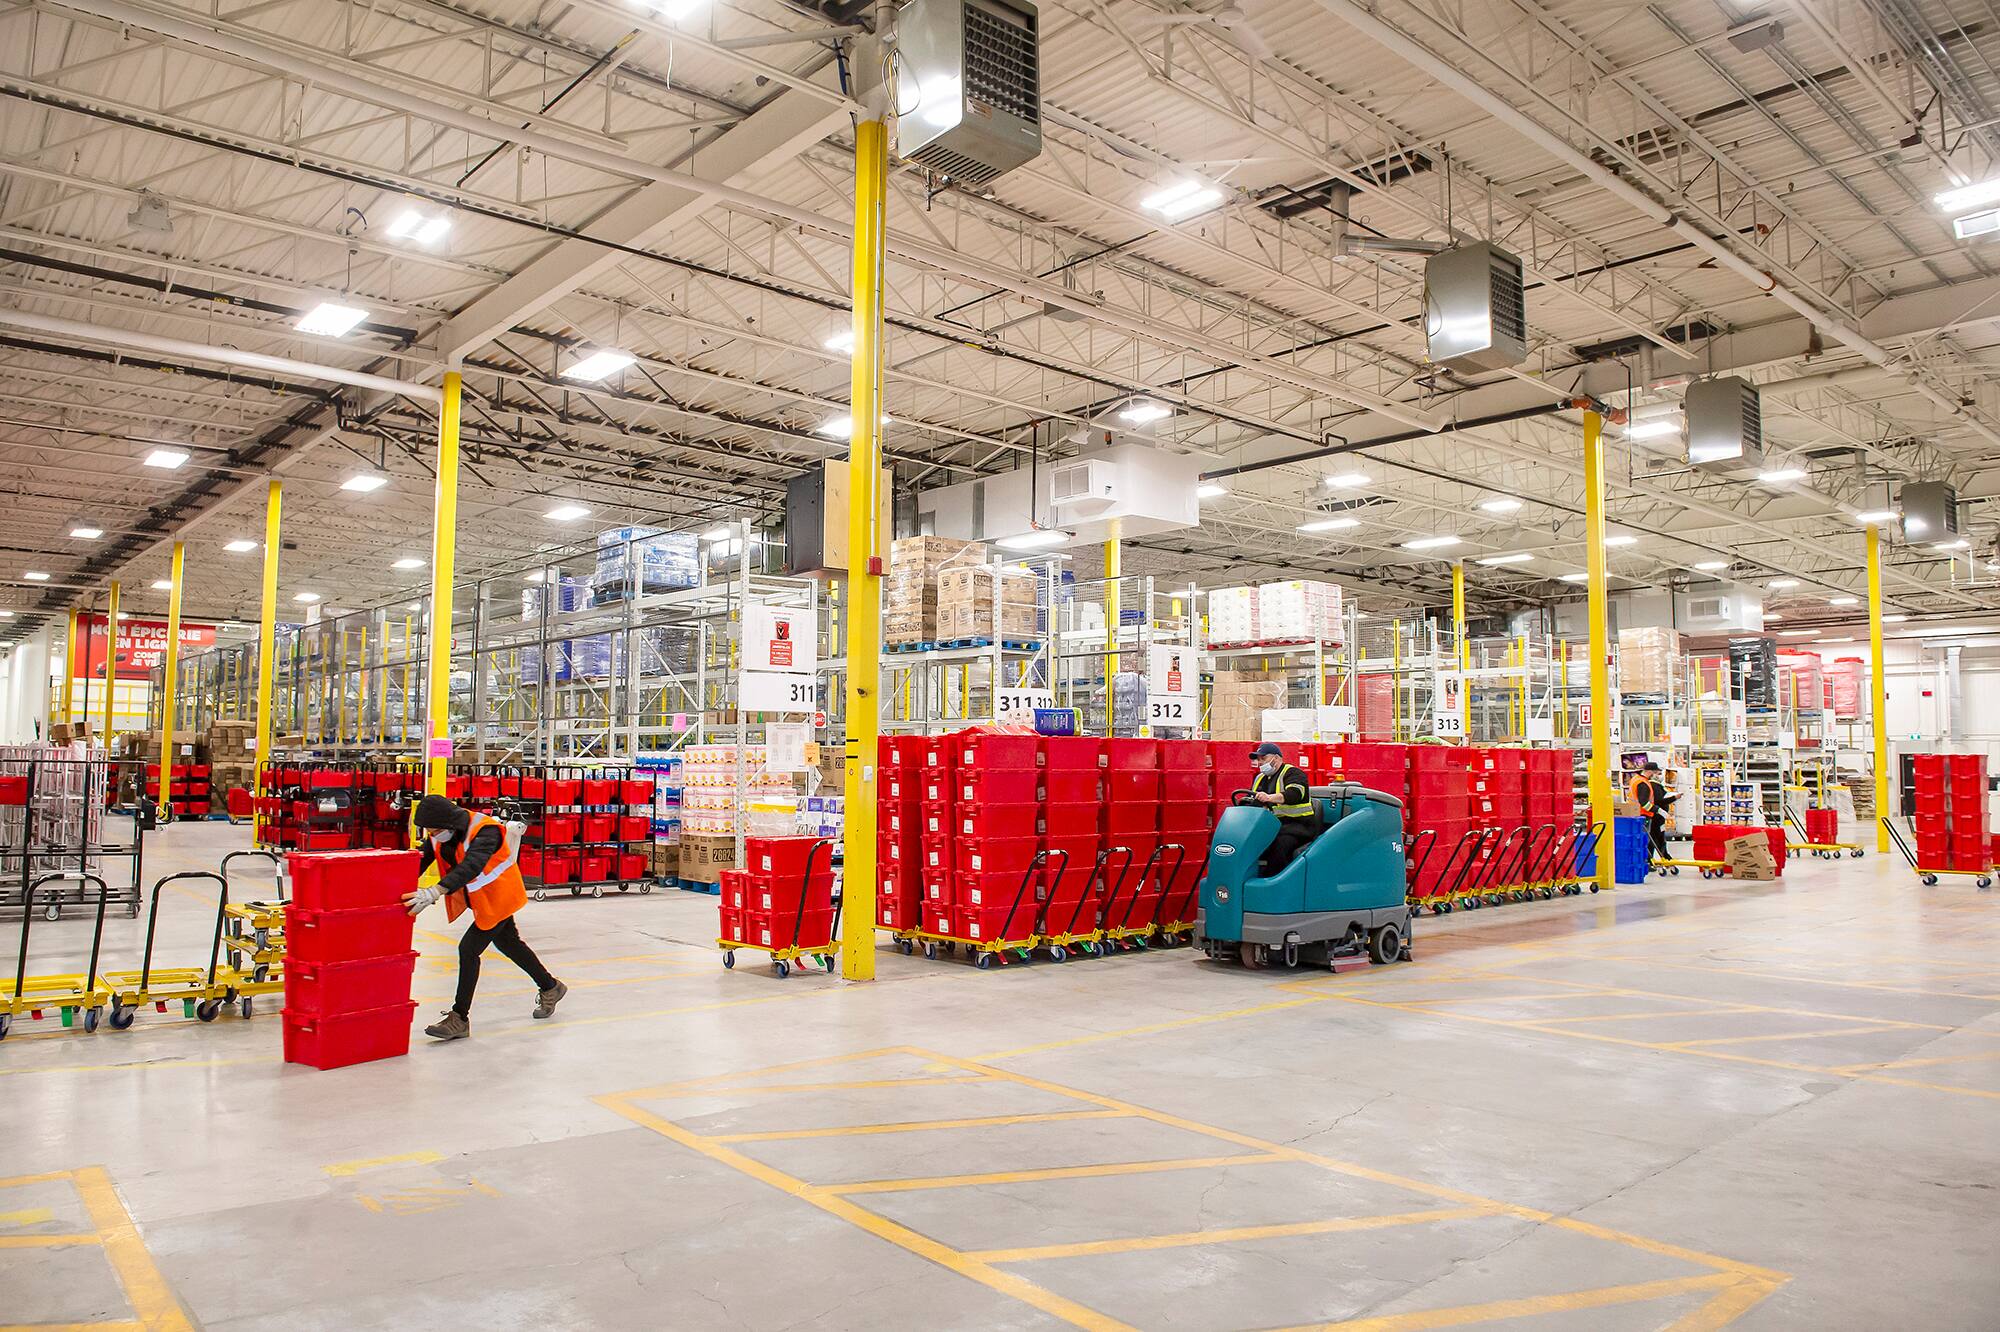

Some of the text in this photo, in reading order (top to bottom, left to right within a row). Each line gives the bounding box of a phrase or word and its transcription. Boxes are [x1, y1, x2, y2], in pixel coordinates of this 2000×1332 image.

[131, 624, 202, 641] ÉPICRIE
[135, 638, 181, 651] LIGN
[790, 683, 814, 703] 311
[999, 695, 1032, 712] 311
[1152, 703, 1182, 718] 312
[1437, 718, 1460, 730] 313
[1609, 727, 1620, 737] 14
[1732, 733, 1747, 744] 315
[1825, 738, 1838, 747] 316
